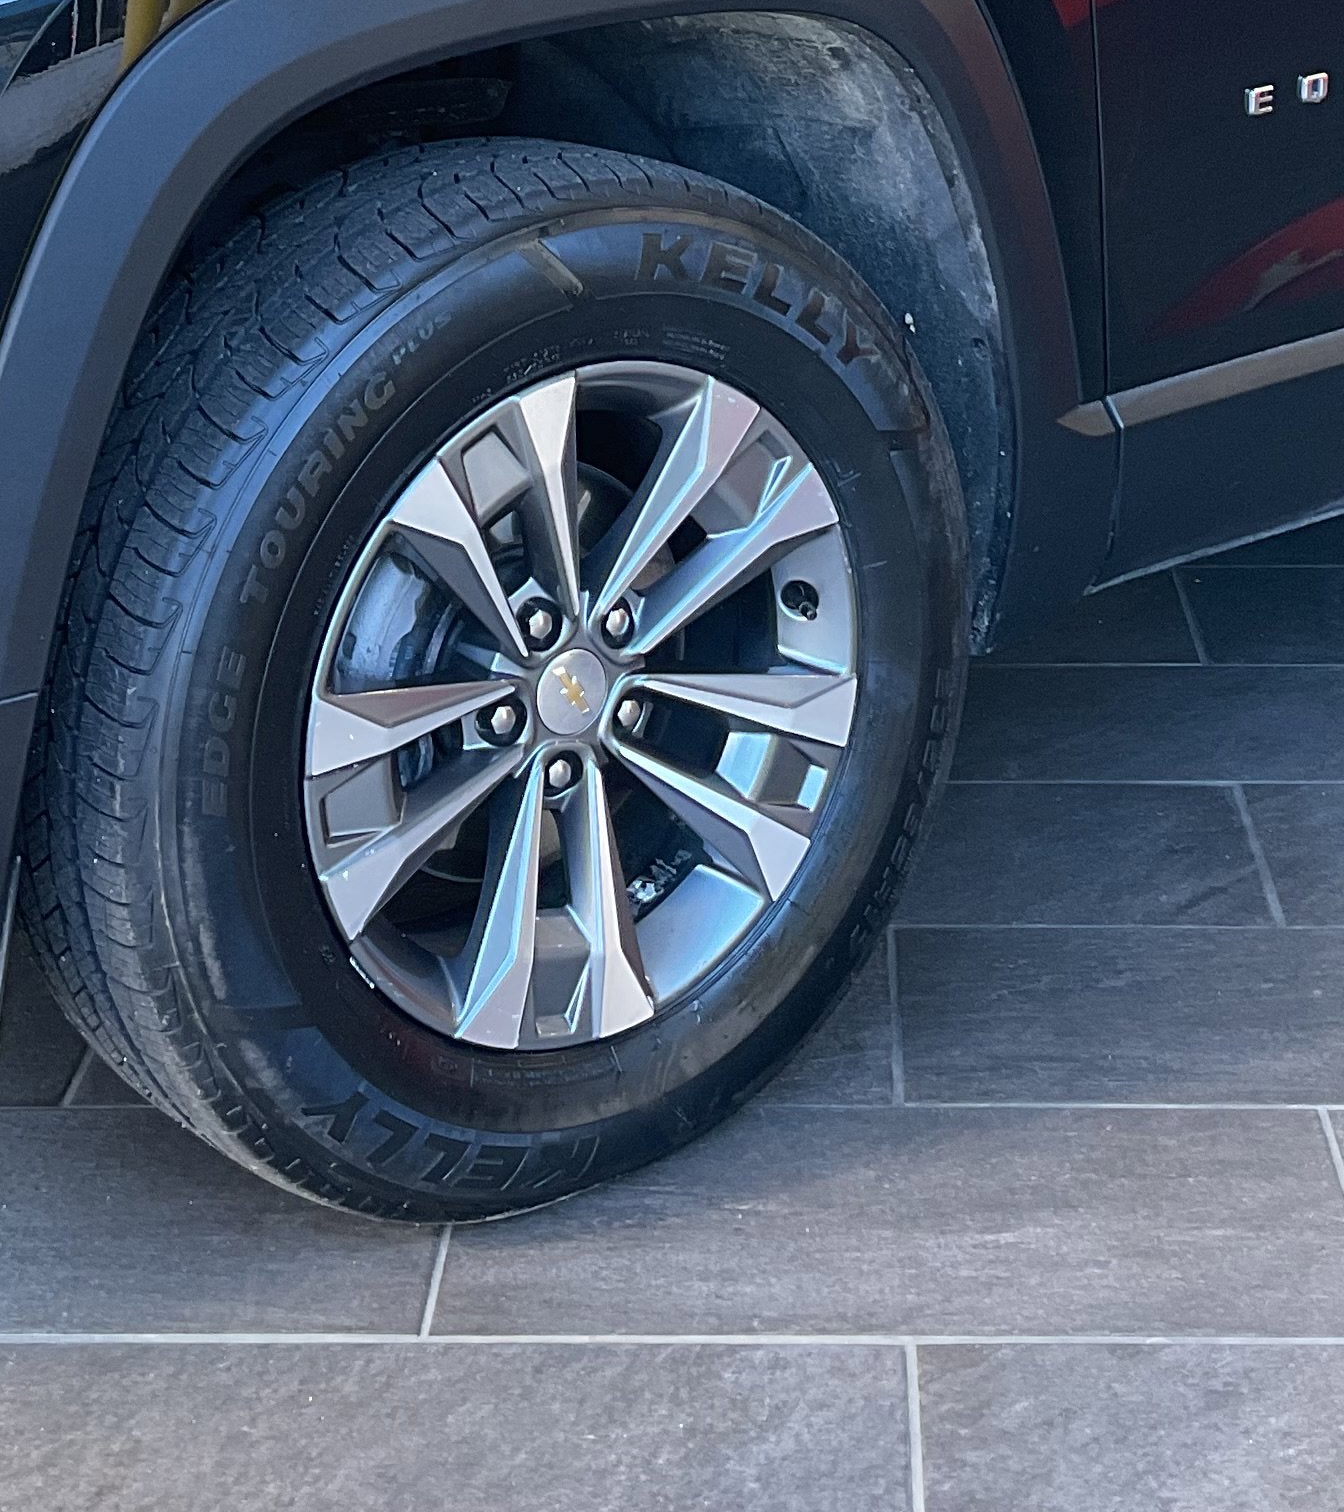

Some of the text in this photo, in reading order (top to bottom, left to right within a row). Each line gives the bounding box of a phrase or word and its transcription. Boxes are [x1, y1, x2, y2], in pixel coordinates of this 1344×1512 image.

[634, 232, 881, 366] KELLY
[200, 645, 247, 818] EDGE
[239, 370, 396, 607] TOURING
[392, 310, 453, 366] PLUS
[301, 1090, 601, 1190] KELLY
